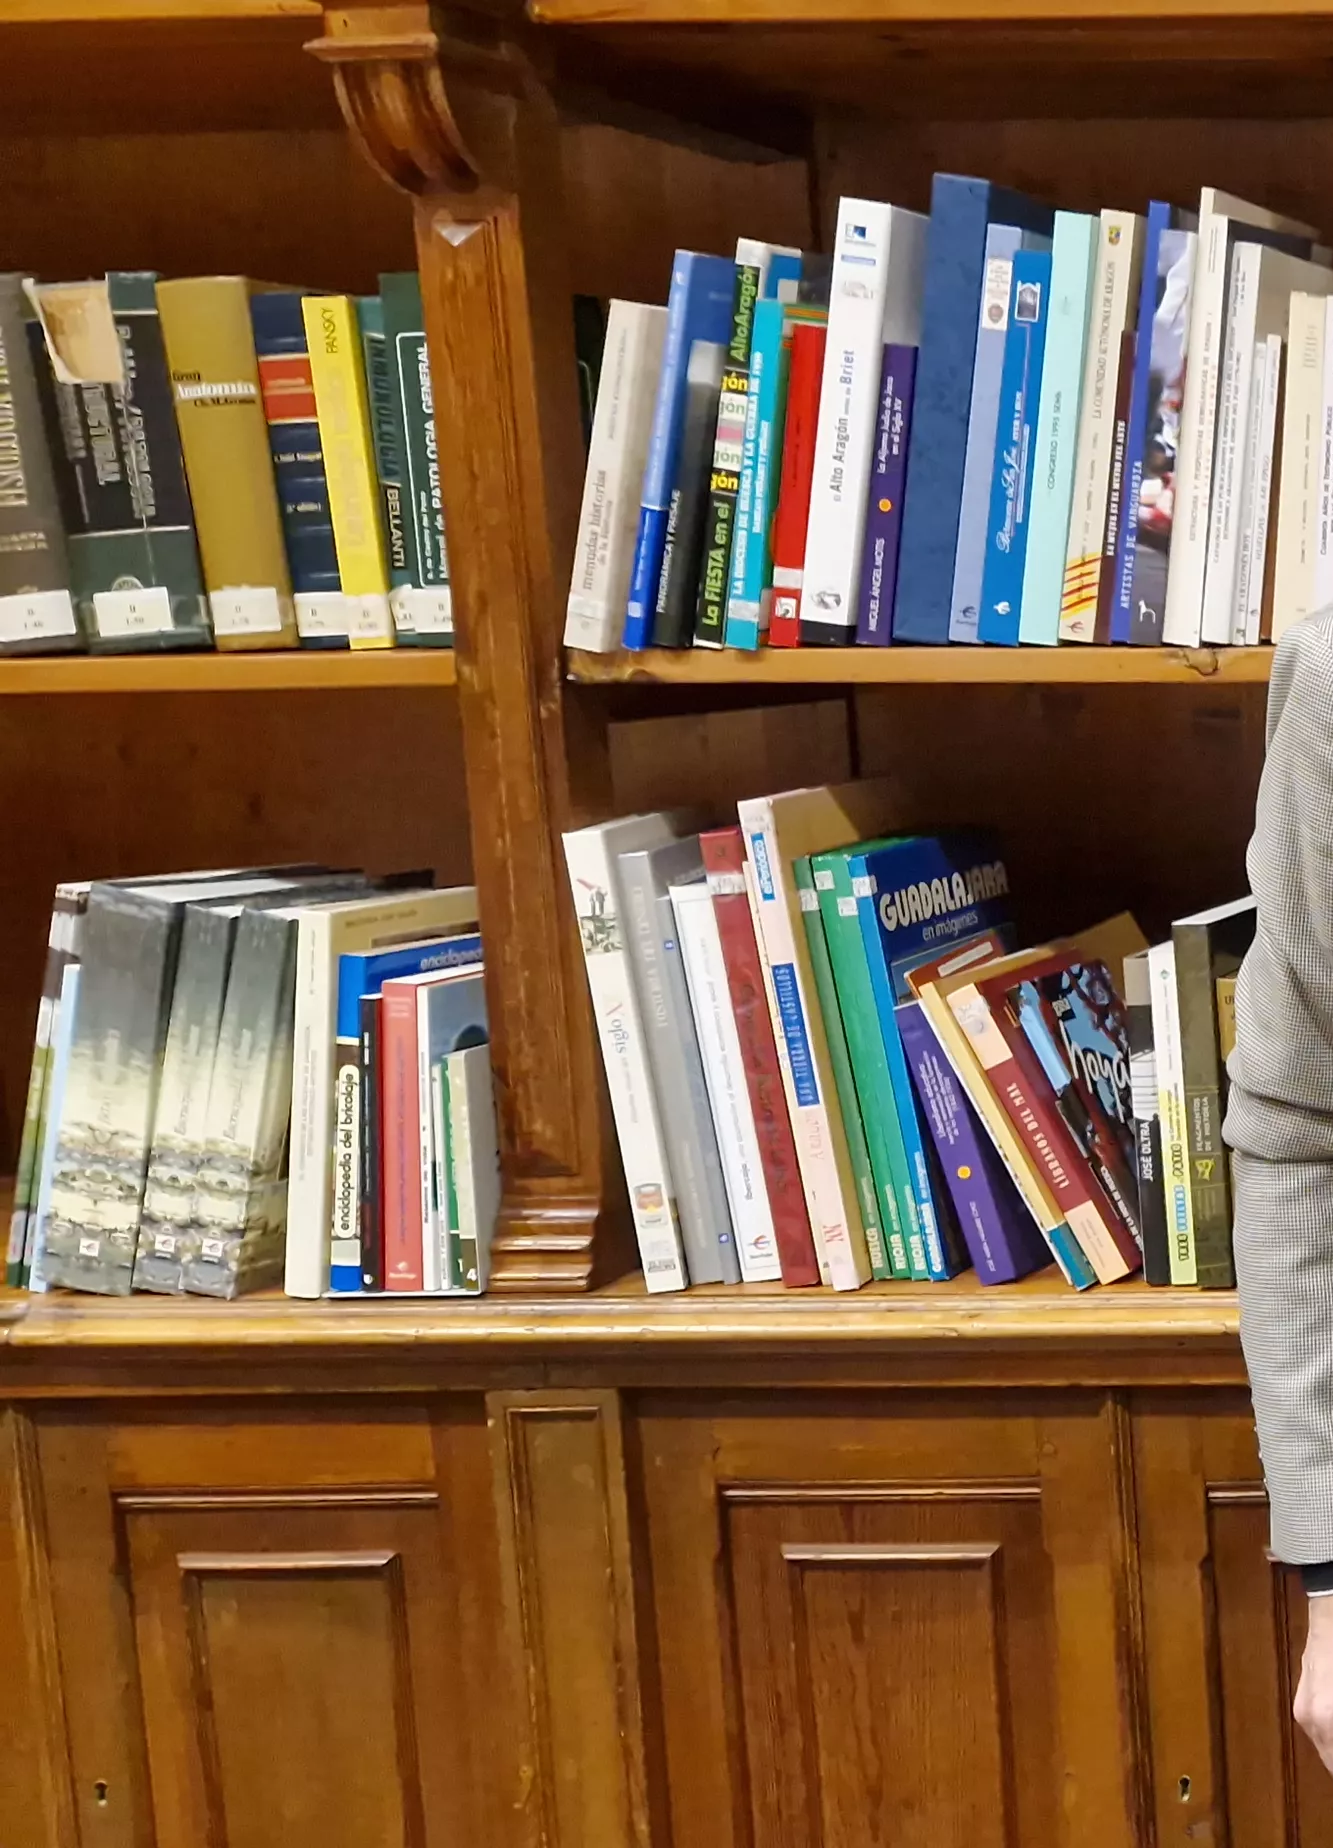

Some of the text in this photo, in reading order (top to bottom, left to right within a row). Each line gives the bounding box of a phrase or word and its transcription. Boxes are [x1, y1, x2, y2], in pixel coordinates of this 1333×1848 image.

[321, 307, 338, 354] PANSKY
[830, 350, 855, 493] Alto Aragón Briet
[386, 487, 405, 567] BELLANTI
[1120, 461, 1143, 608] ARTISTAS DE VANGUARDIA
[702, 502, 729, 626] La FIESTA en el
[880, 860, 1009, 931] GUADALAJARA
[923, 910, 978, 941] en imágenes
[1007, 1082, 1030, 1106] MAL
[1017, 1106, 1038, 1131] DEL
[338, 1073, 355, 1231] enciclopedia del bricolaje
[1139, 1122, 1154, 1181] JOSÉ OLTRA
